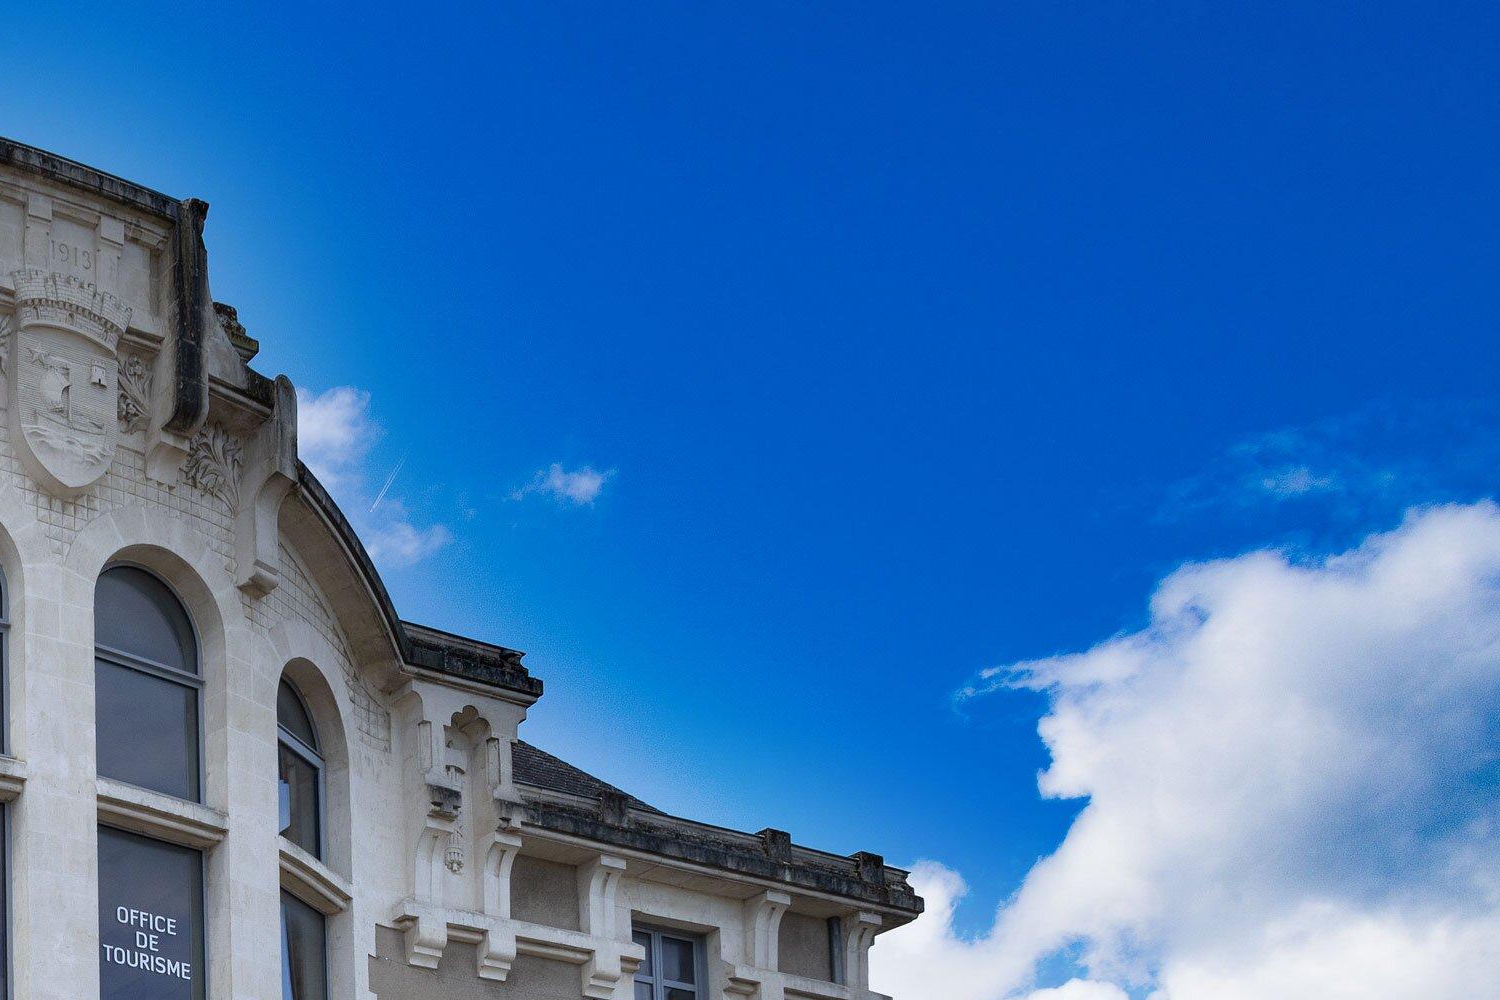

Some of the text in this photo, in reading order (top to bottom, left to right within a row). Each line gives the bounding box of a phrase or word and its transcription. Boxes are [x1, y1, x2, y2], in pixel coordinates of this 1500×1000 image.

[50, 240, 92, 270] 1913
[116, 906, 177, 936] OFFICE
[135, 931, 159, 952] DE
[103, 944, 191, 980] TOURISME
